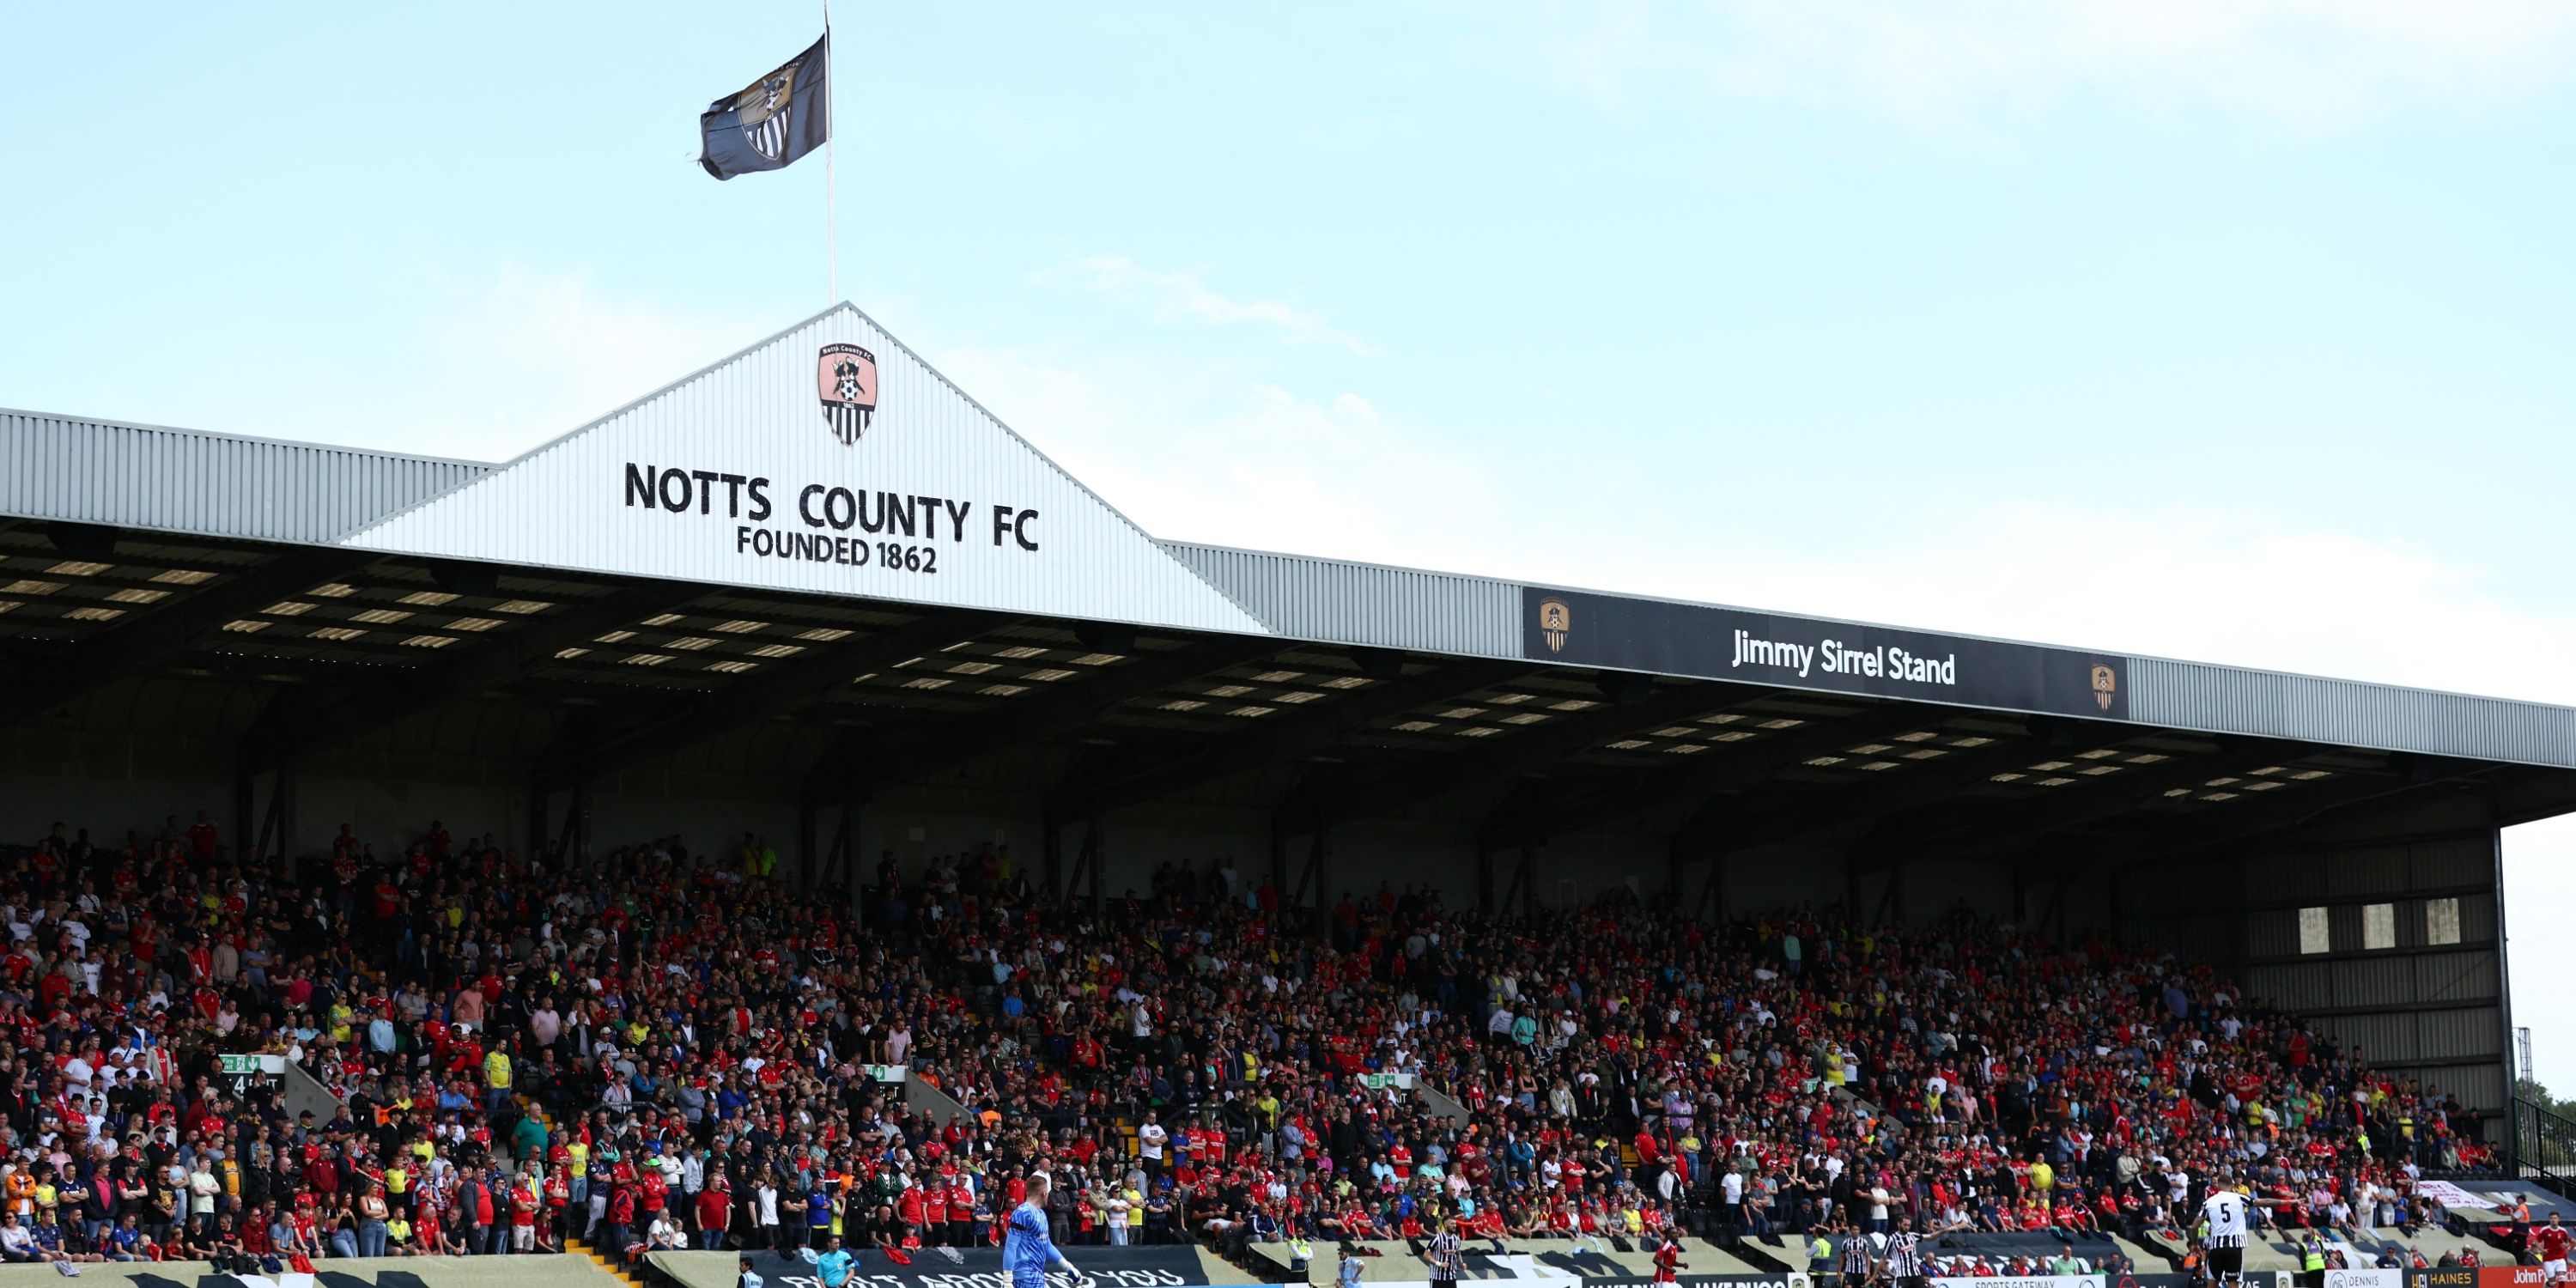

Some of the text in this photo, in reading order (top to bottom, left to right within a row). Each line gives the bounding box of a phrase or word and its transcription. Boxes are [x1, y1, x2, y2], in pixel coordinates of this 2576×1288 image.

[841, 345, 863, 355] County
[625, 462, 1039, 552] NOTTS COUNTY FC
[737, 526, 937, 574] FOUNDED 1862
[1731, 629, 1955, 686] Jimmy Sirrel Stand
[2221, 1203, 2231, 1223] 5
[2348, 1276, 2379, 1286] DENNIS
[2429, 1273, 2472, 1285] HAINES
[2513, 1269, 2537, 1284] John
